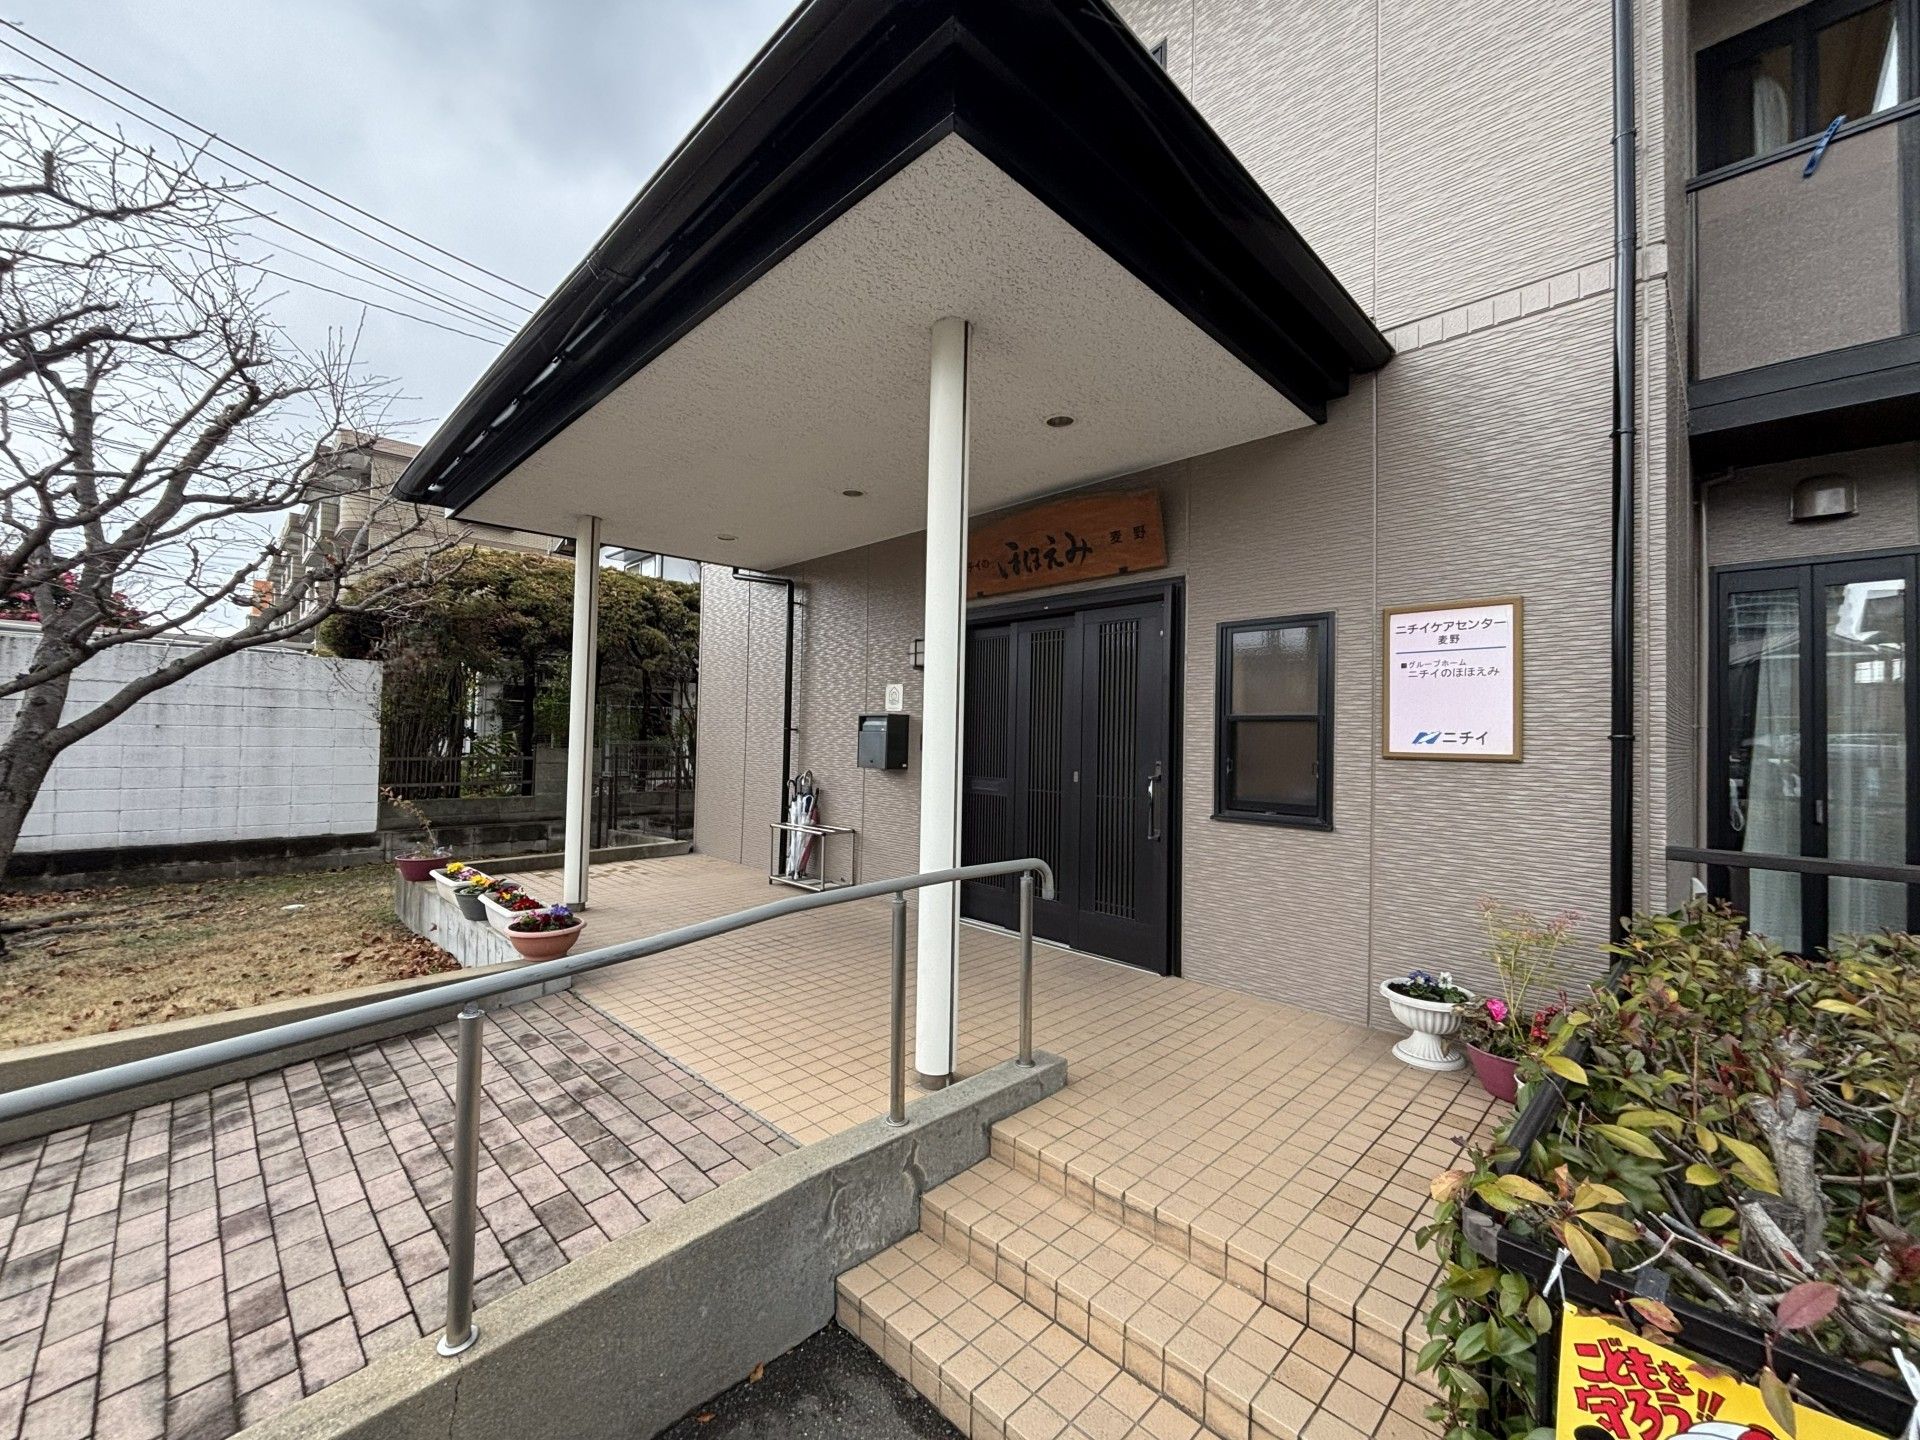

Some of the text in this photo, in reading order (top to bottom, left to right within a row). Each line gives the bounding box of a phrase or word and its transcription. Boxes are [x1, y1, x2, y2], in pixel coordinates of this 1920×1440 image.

[997, 531, 1093, 579] ほほえみ
[1395, 618, 1507, 635] ニチイケアセンター
[1438, 634, 1460, 645] 麦野
[1408, 667, 1500, 679] ニチイのほほえみ
[1443, 731, 1488, 745] ニチイ
[1574, 1337, 1695, 1396] こどもを
